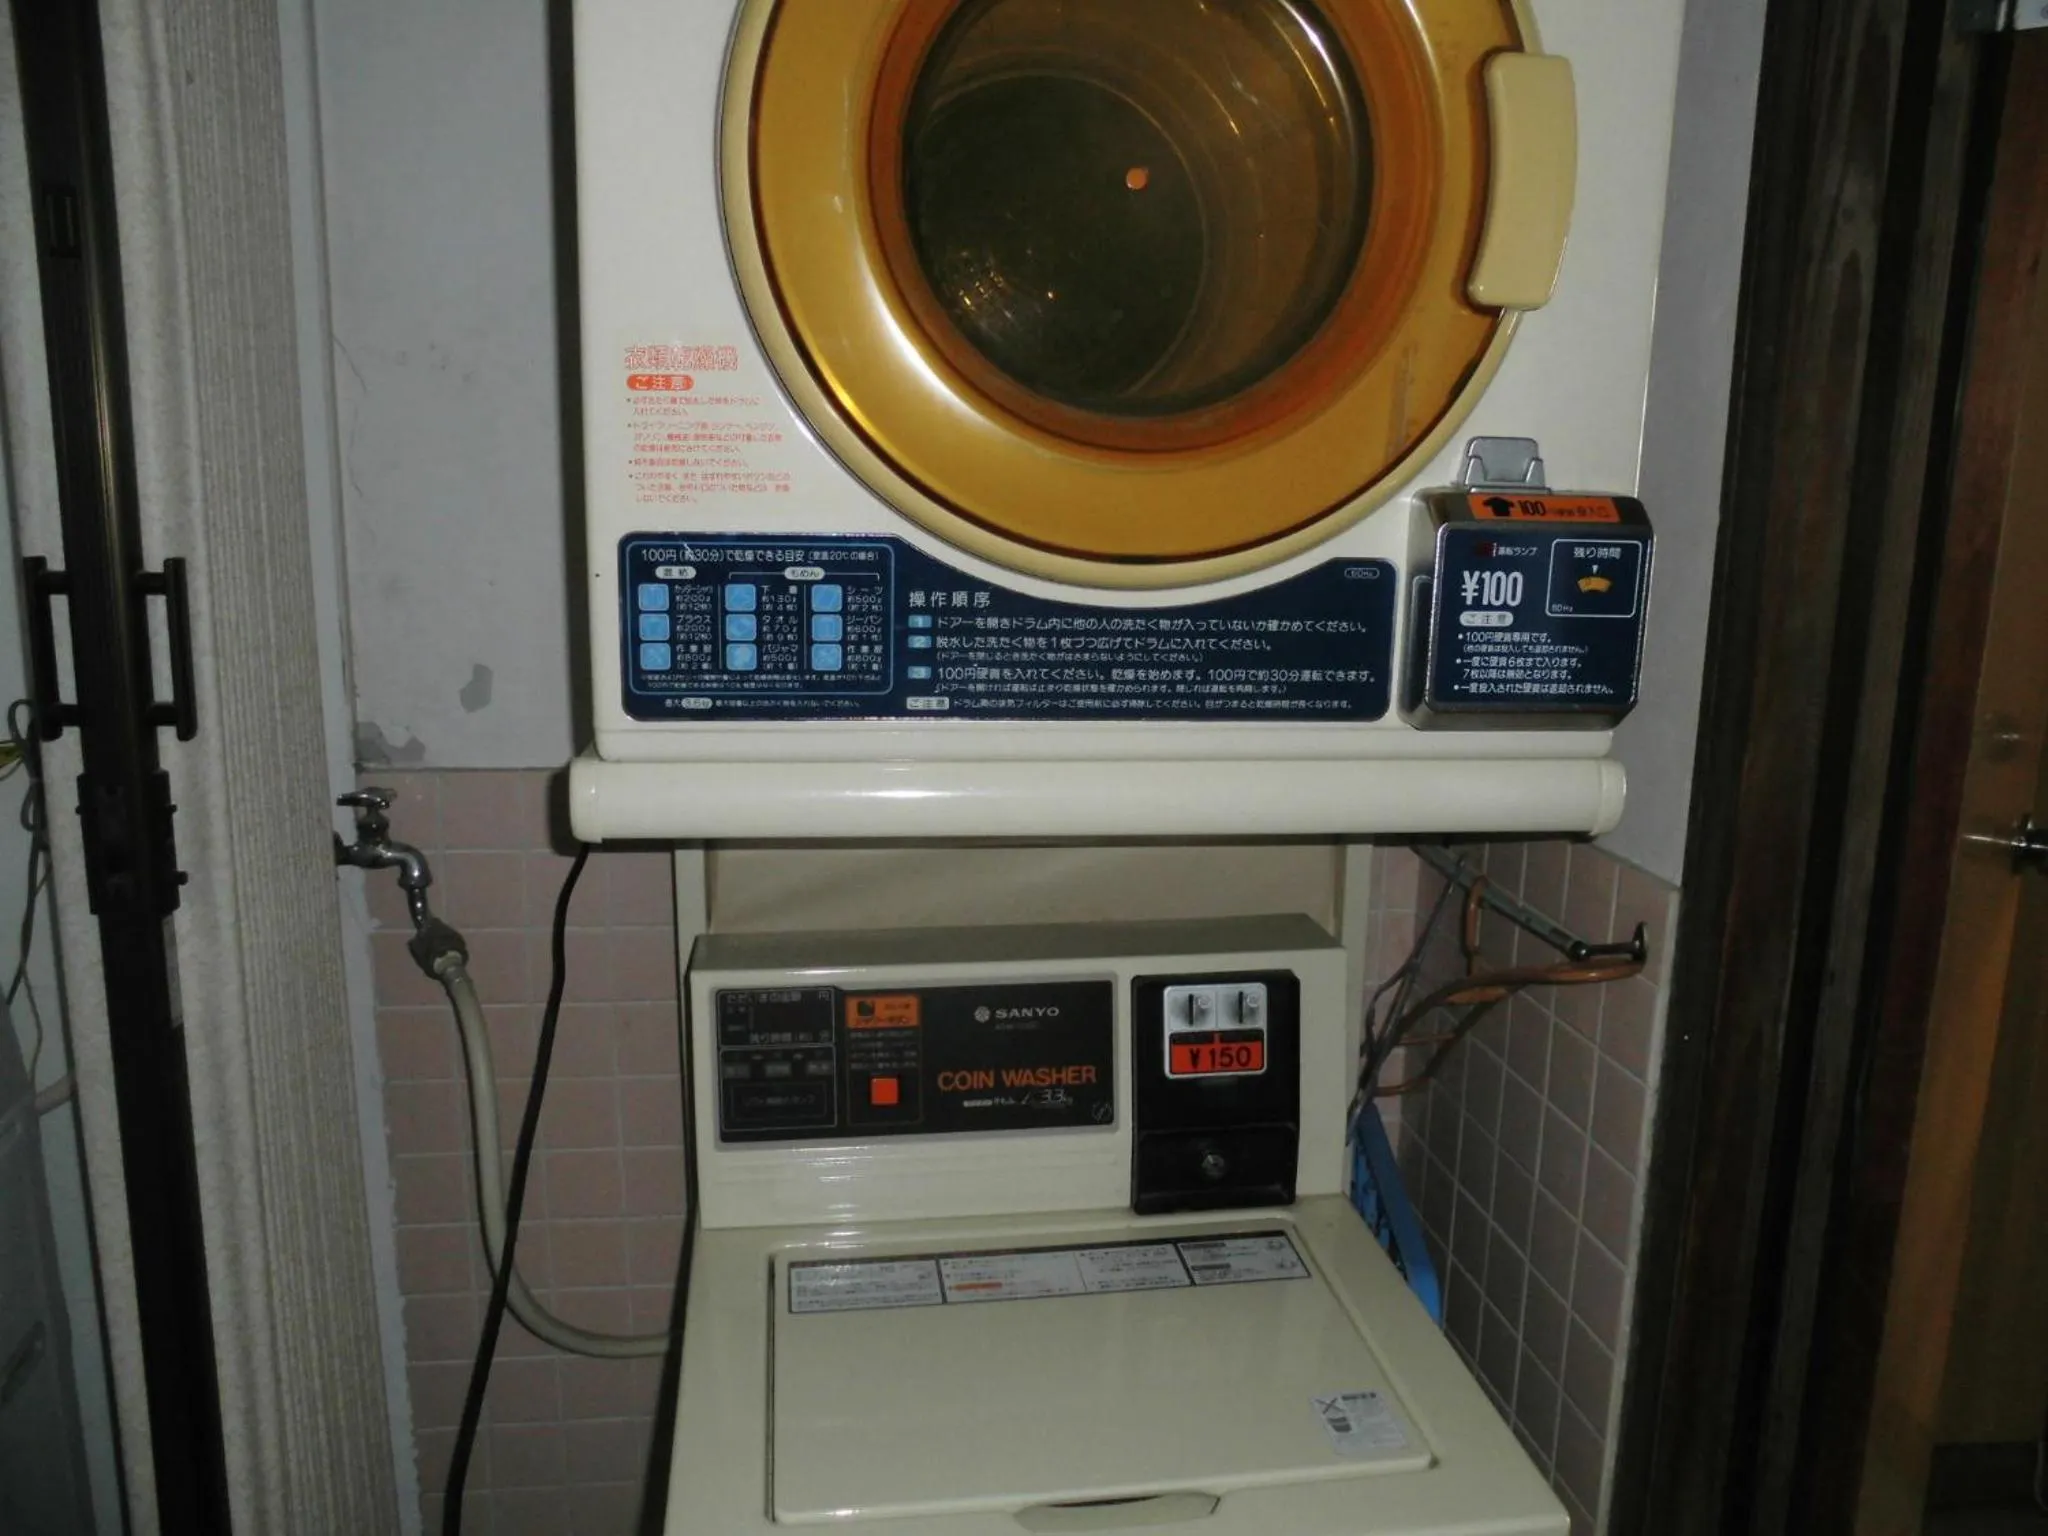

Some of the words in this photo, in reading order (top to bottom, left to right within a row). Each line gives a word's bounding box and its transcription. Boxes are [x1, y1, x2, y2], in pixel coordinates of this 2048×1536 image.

[636, 376, 684, 390] ご注意
[1518, 500, 1546, 516] 100
[1573, 546, 1622, 560] 残り時間
[1461, 570, 1524, 607] ¥100
[909, 591, 991, 608] 操作順序
[995, 1007, 1060, 1019] SANYO
[937, 1069, 995, 1091] COIN
[1002, 1065, 1097, 1087] WASHER
